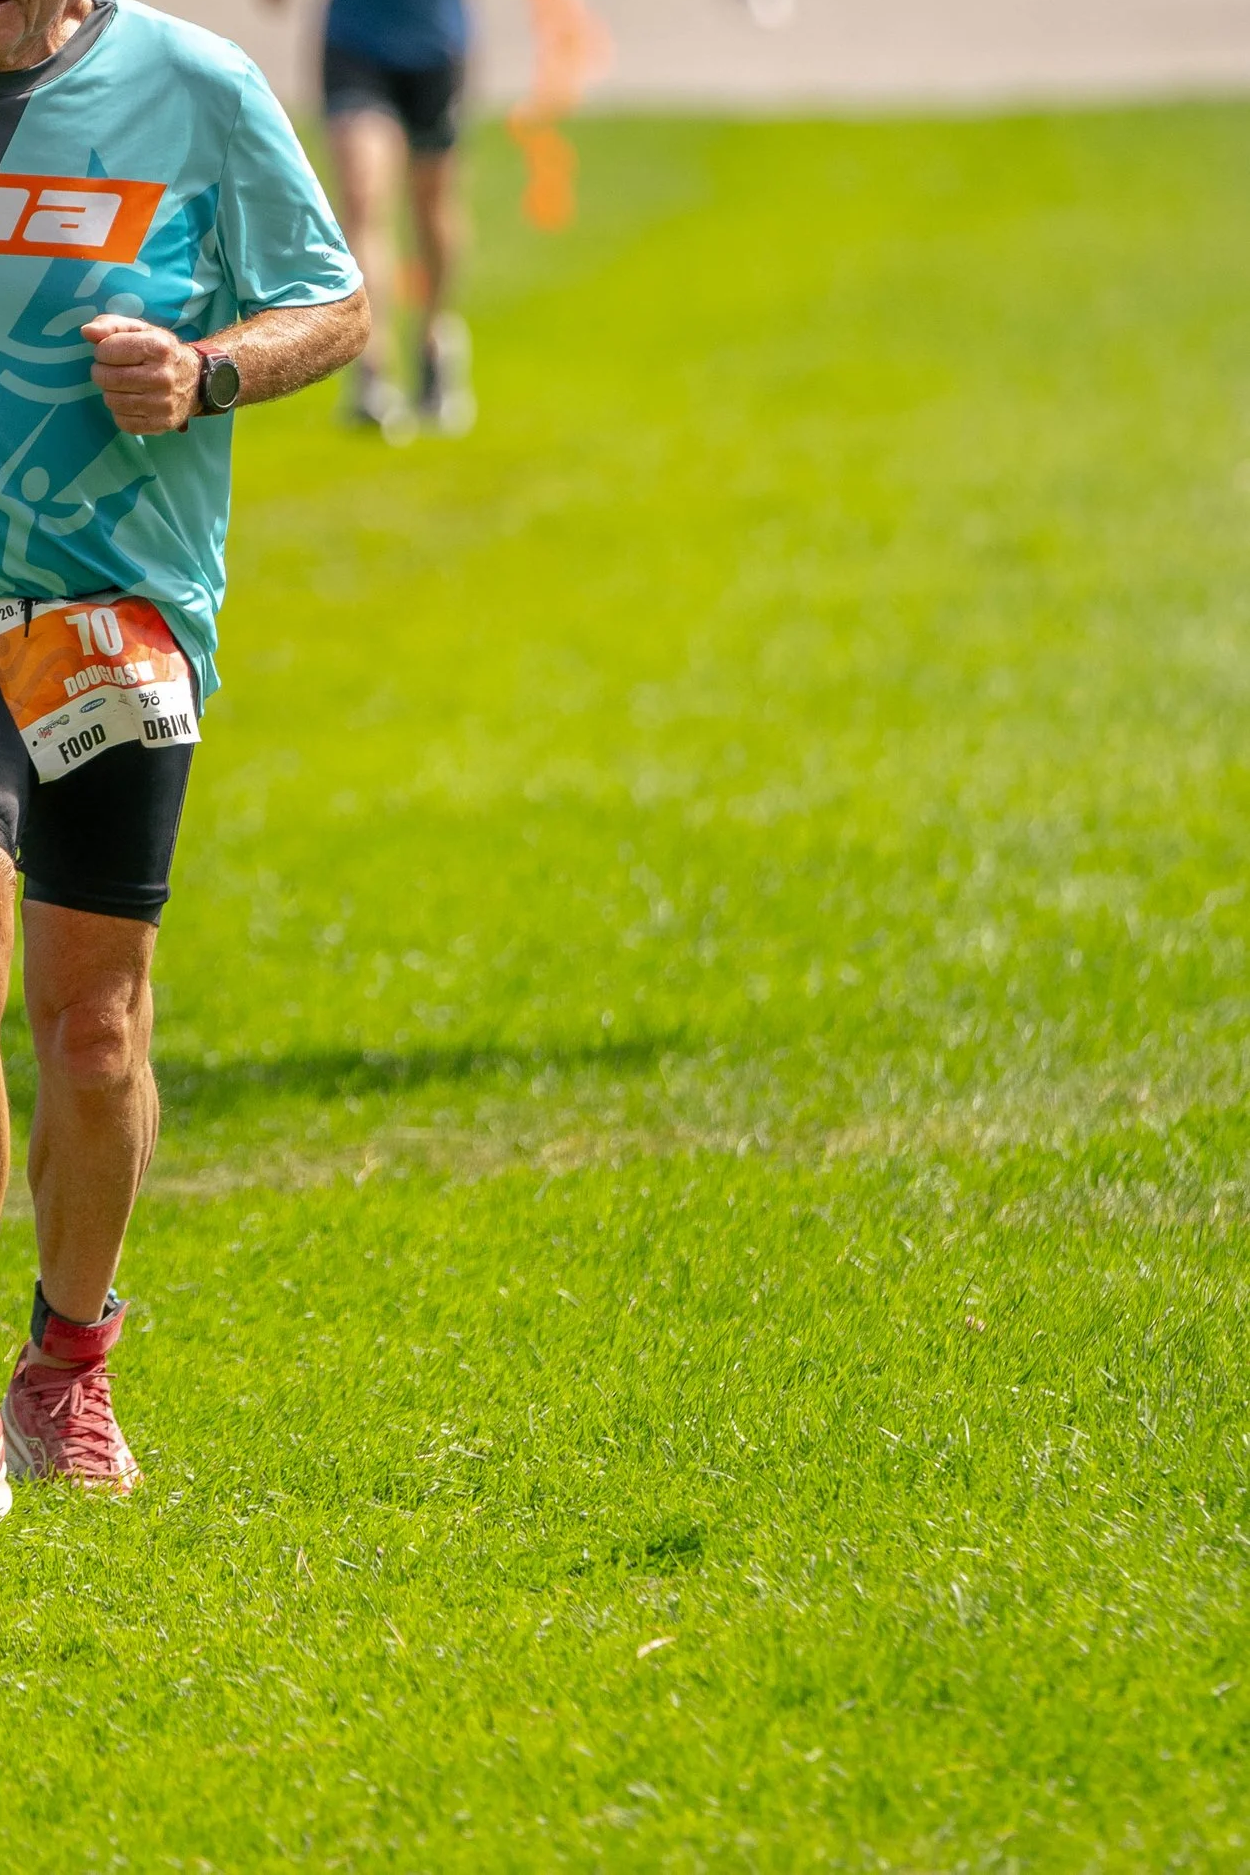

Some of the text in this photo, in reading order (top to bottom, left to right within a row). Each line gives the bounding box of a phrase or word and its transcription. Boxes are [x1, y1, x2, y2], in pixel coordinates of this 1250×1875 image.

[65, 607, 124, 657] 70
[63, 663, 138, 698] DOUGLAS
[140, 696, 160, 709] 70
[58, 723, 106, 765] FOOD
